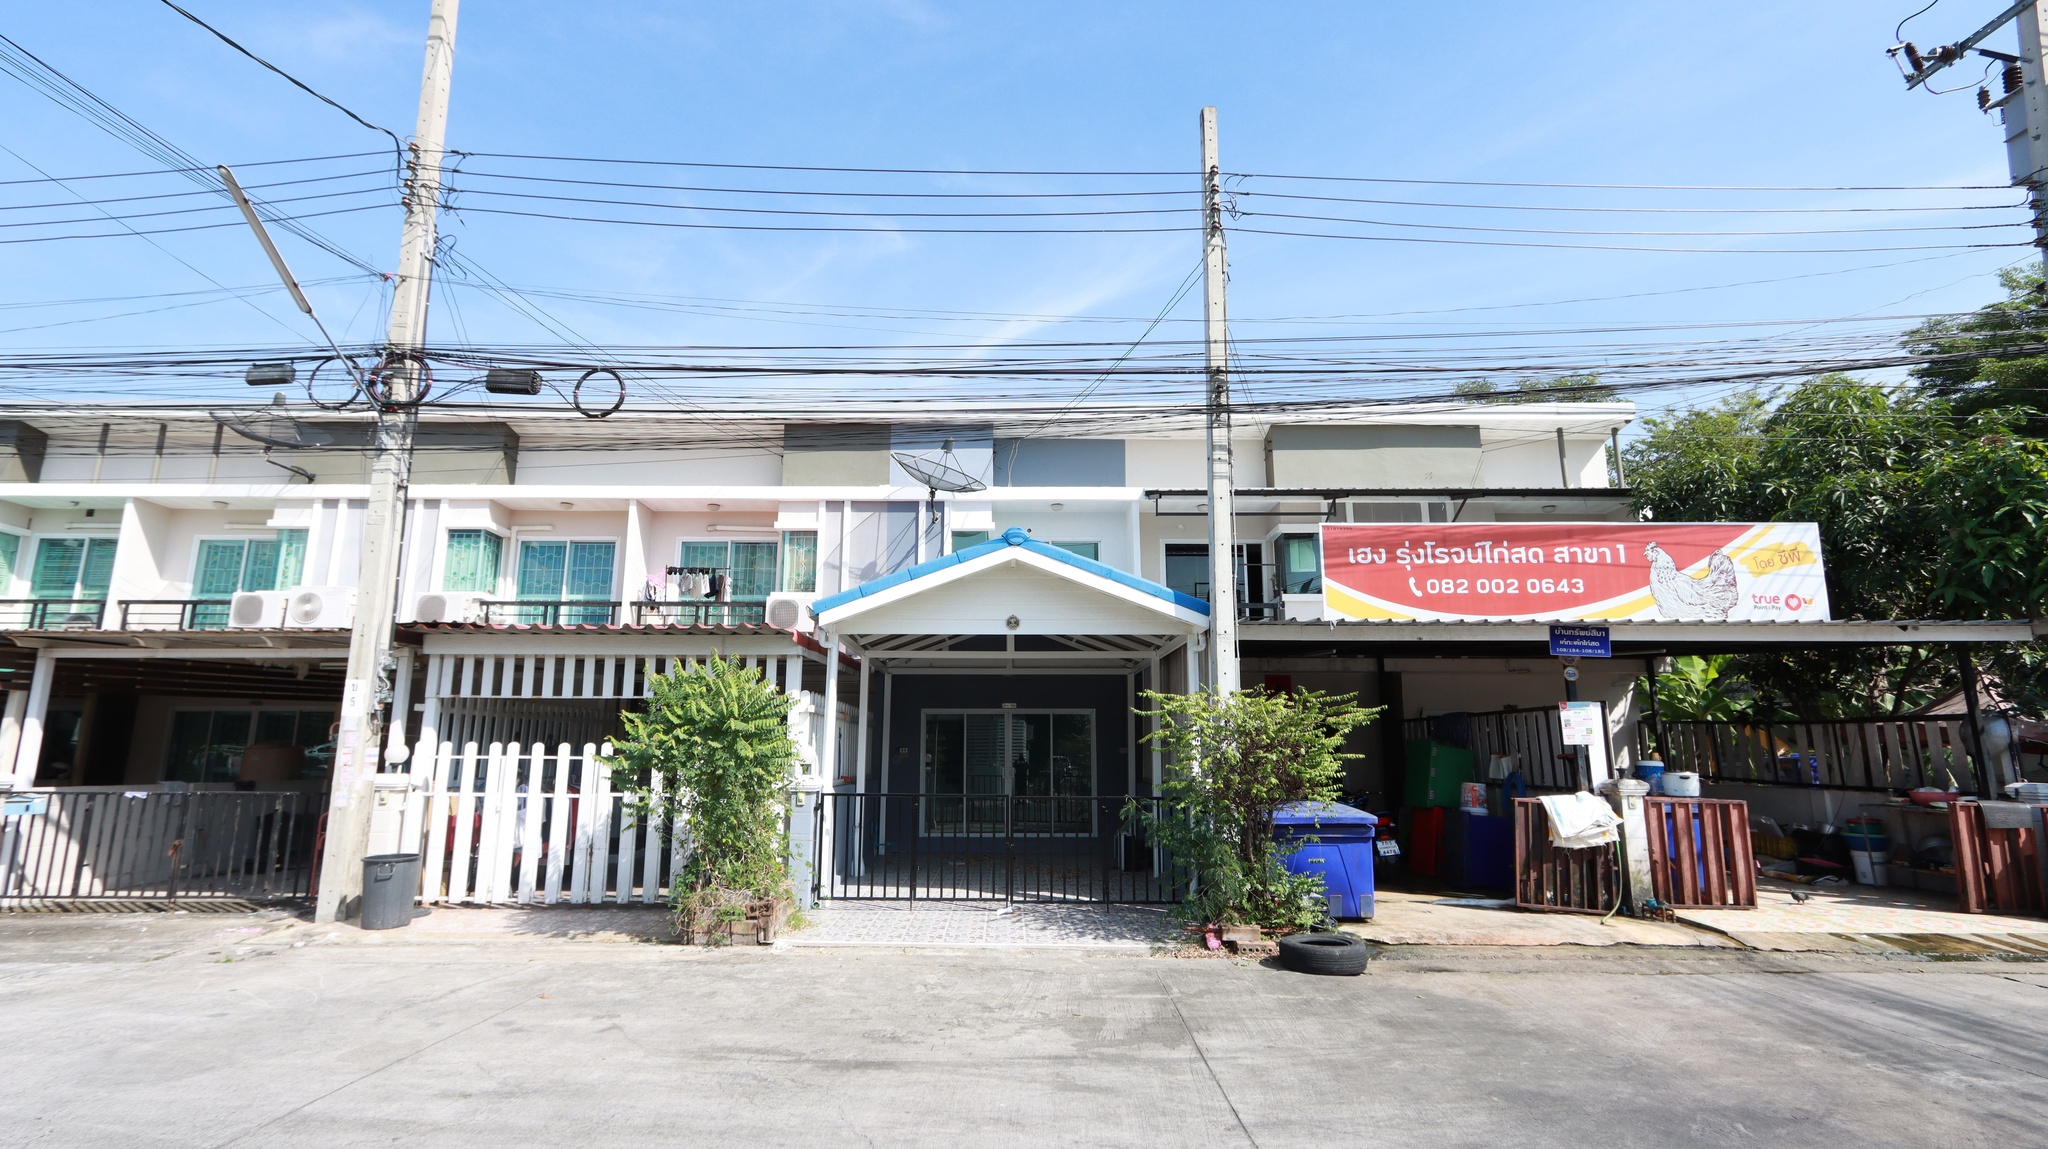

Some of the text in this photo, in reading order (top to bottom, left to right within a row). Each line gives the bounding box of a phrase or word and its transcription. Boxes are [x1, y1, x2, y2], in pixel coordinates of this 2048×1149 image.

[1348, 547, 1387, 564] เฮง
[1396, 540, 1545, 571] รุ่งโรจน์ไก่สด
[1752, 555, 1775, 570] โดย
[1426, 578, 1584, 594] 082 002 0643
[1751, 593, 1780, 604] true
[350, 697, 356, 707] 5
